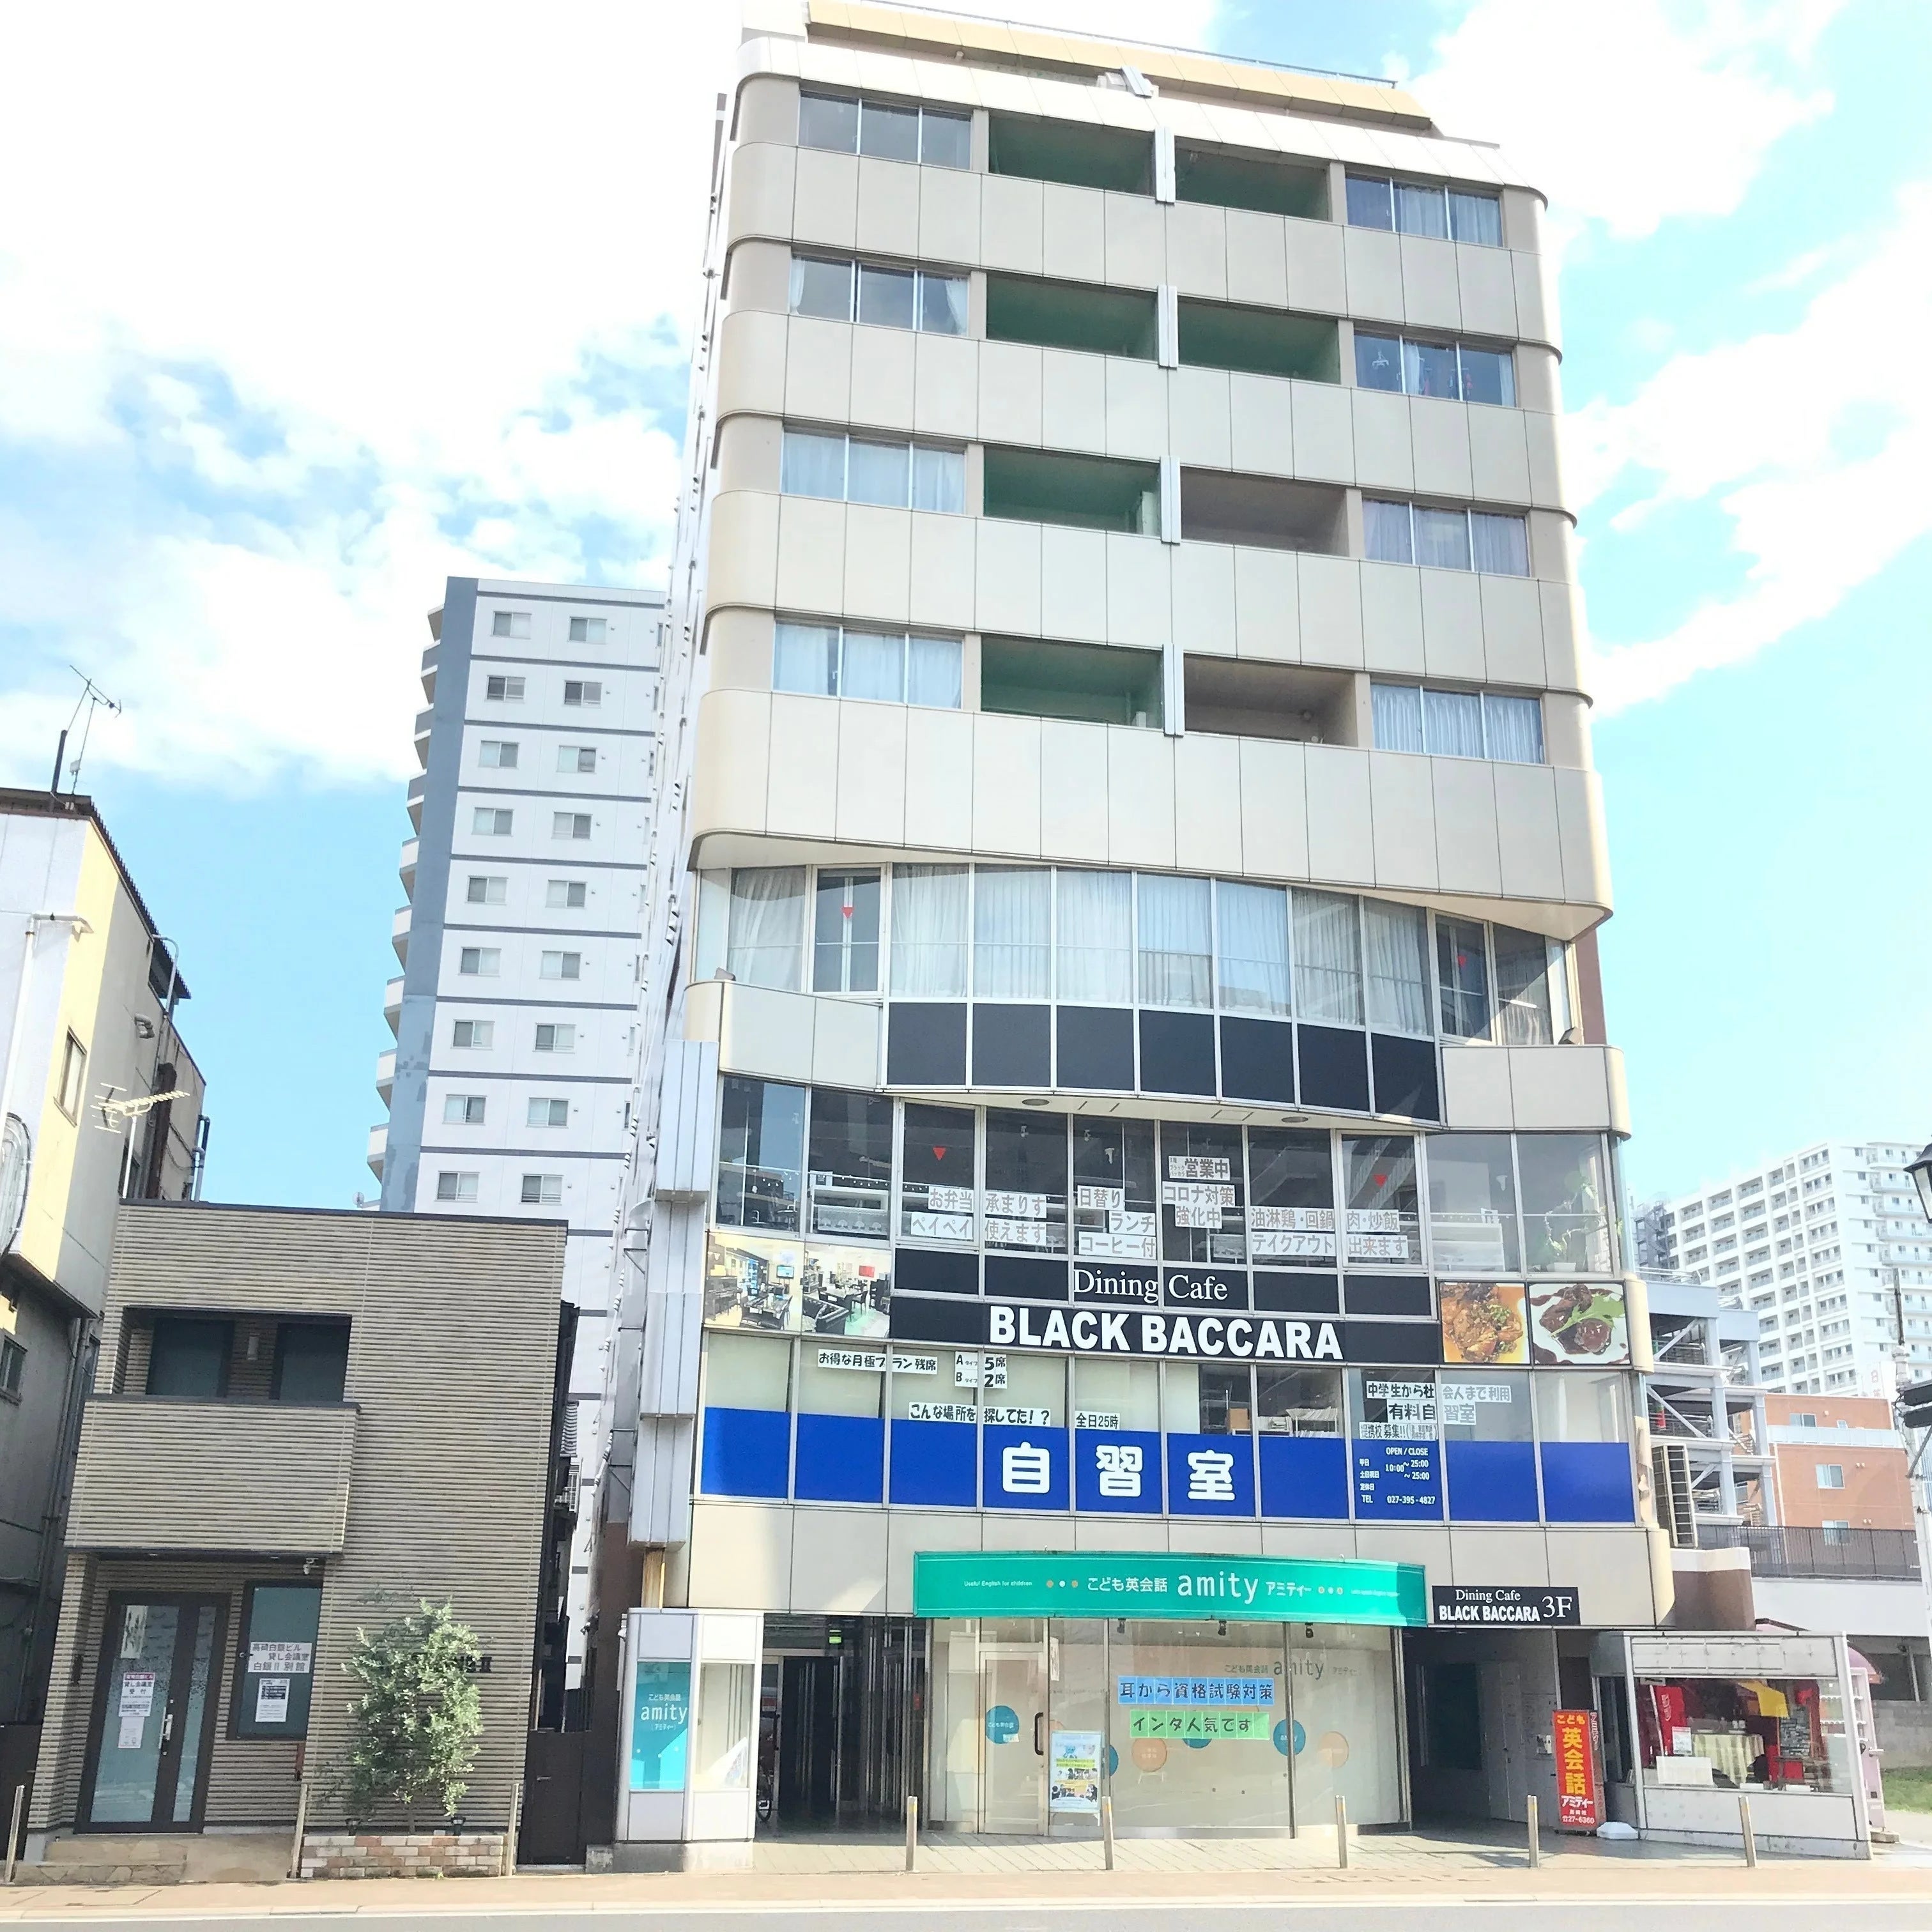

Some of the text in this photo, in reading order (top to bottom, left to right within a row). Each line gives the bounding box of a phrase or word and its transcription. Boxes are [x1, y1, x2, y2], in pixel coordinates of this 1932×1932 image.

[1185, 1158, 1228, 1178] 営業中
[1080, 1188, 1121, 1209] 日替り
[1164, 1186, 1234, 1206] コロナ対策
[1111, 1213, 1154, 1233] ランチ
[1176, 1206, 1220, 1227] 強化中
[1081, 1237, 1156, 1257] コーヒー付
[1073, 1269, 1228, 1303] Dining Cafe
[990, 1305, 1343, 1360] BLACK BACCARA
[1075, 1413, 1119, 1430] 全日25時
[1361, 1494, 1374, 1503] TEL
[1087, 1571, 1312, 1604] こども英会話 amity アミティー
[1439, 1605, 1540, 1621] BLACK BACCARA
[1455, 1590, 1572, 1618] Dining Cafe 3F
[1119, 1682, 1273, 1699] 耳から資格試験対策
[641, 1703, 687, 1724] amity
[1556, 1715, 1586, 1725] こども
[1562, 1727, 1586, 1795] 英会話
[1561, 1795, 1593, 1809] アミティー
